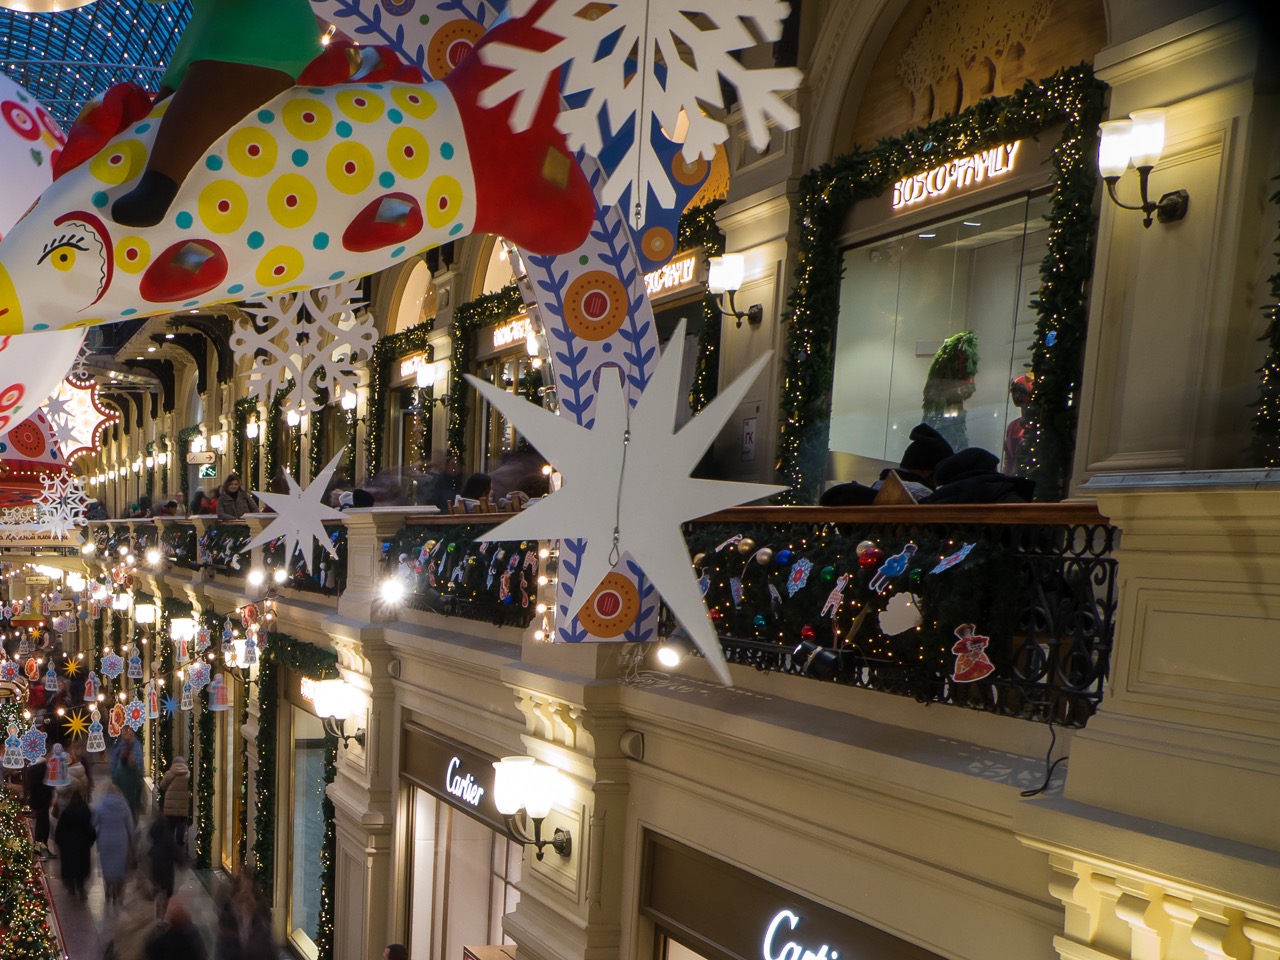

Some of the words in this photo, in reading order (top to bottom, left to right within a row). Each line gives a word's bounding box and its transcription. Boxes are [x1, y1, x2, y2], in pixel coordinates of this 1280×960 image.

[892, 164, 951, 210] BOSCO
[953, 139, 1021, 188] FAMILY
[446, 756, 484, 806] Cartier
